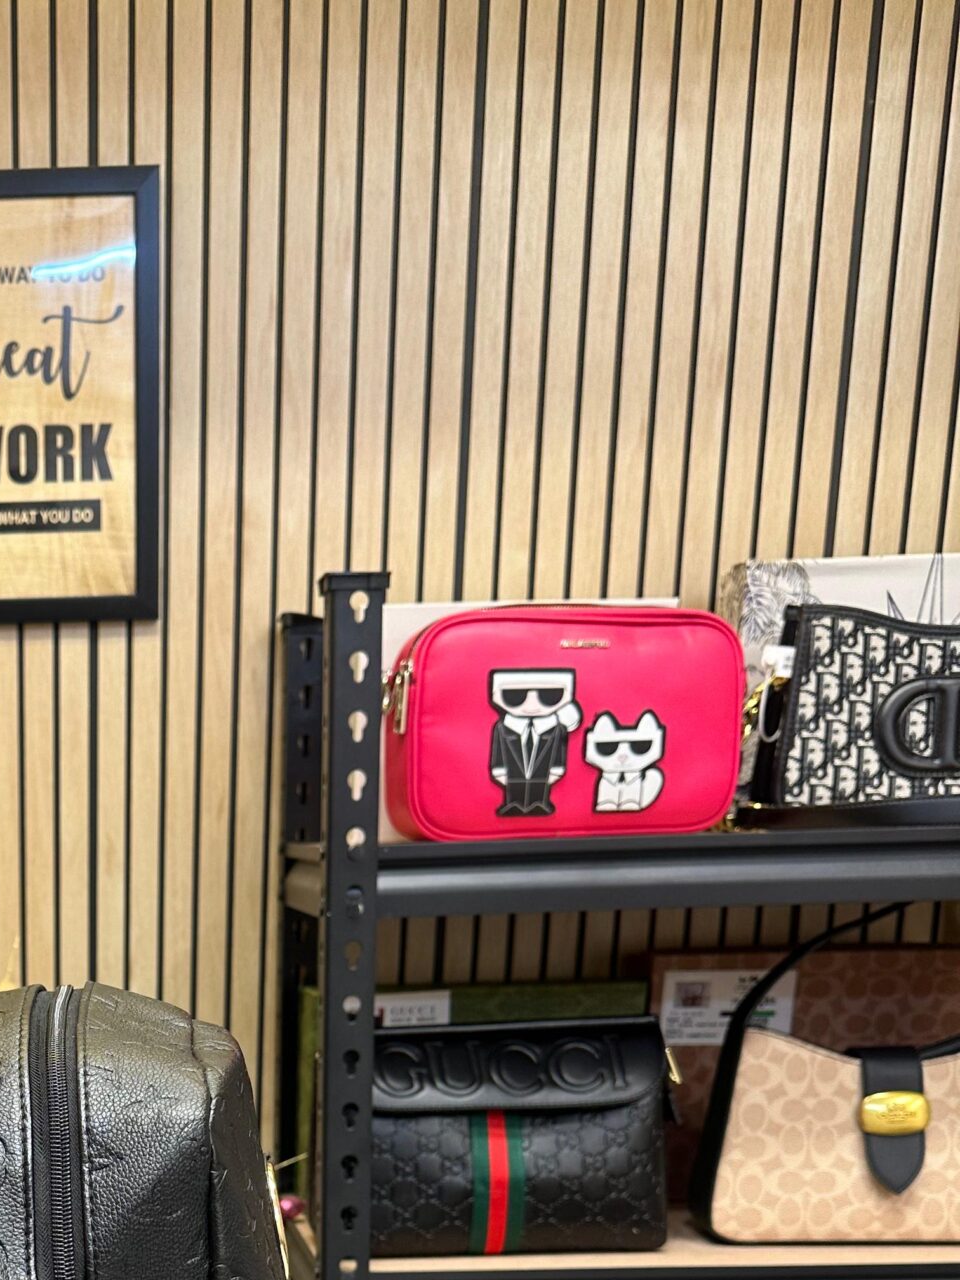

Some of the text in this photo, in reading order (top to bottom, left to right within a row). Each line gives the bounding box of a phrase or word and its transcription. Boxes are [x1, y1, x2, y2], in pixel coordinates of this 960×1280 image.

[40, 508, 71, 524] YOU
[72, 507, 94, 523] DO
[372, 1035, 630, 1098] GUCCI
